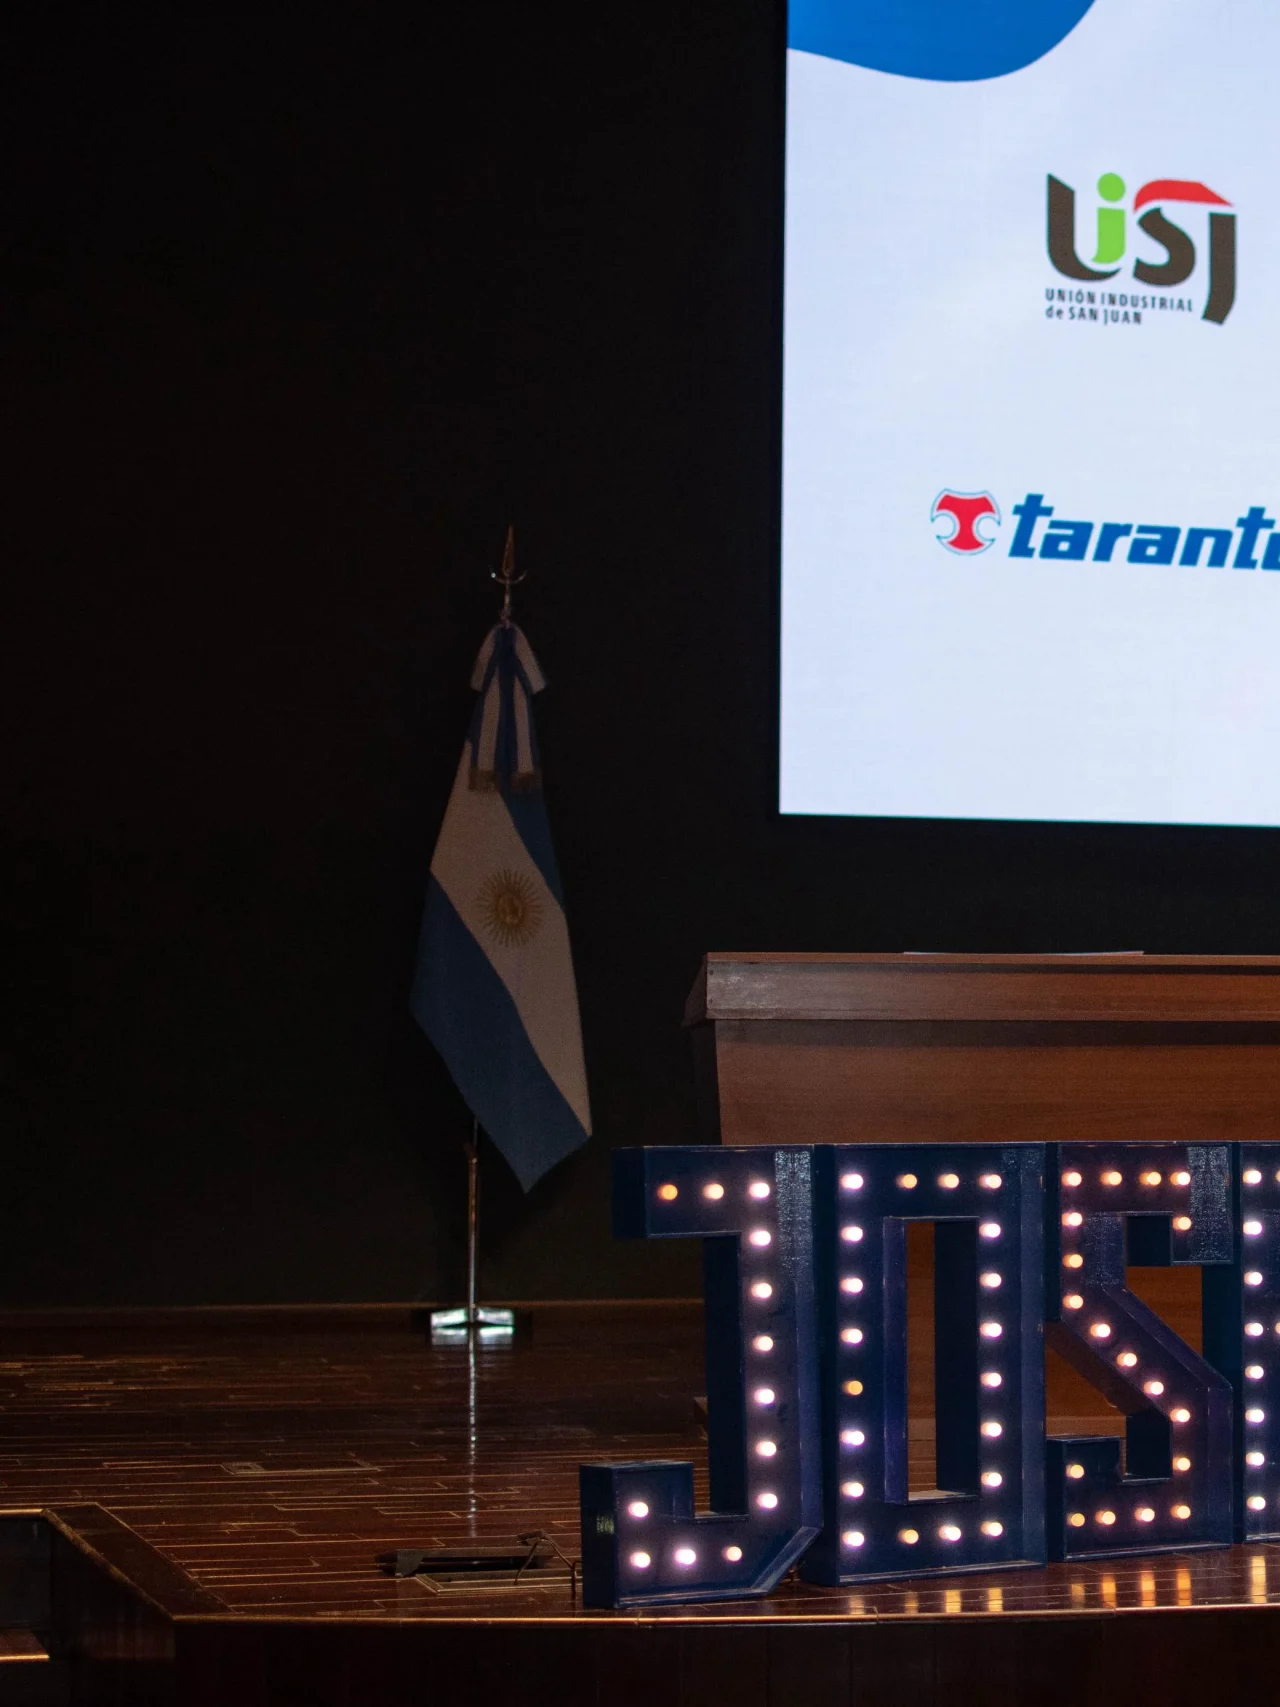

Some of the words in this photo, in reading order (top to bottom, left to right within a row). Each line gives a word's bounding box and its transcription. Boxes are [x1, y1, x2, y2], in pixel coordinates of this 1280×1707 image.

[1046, 288, 1096, 306] UNIÓN
[1101, 292, 1193, 312] INDUSTRIAL
[1046, 307, 1064, 319] de
[1068, 308, 1098, 321] SAN
[1103, 311, 1142, 325] JUAN
